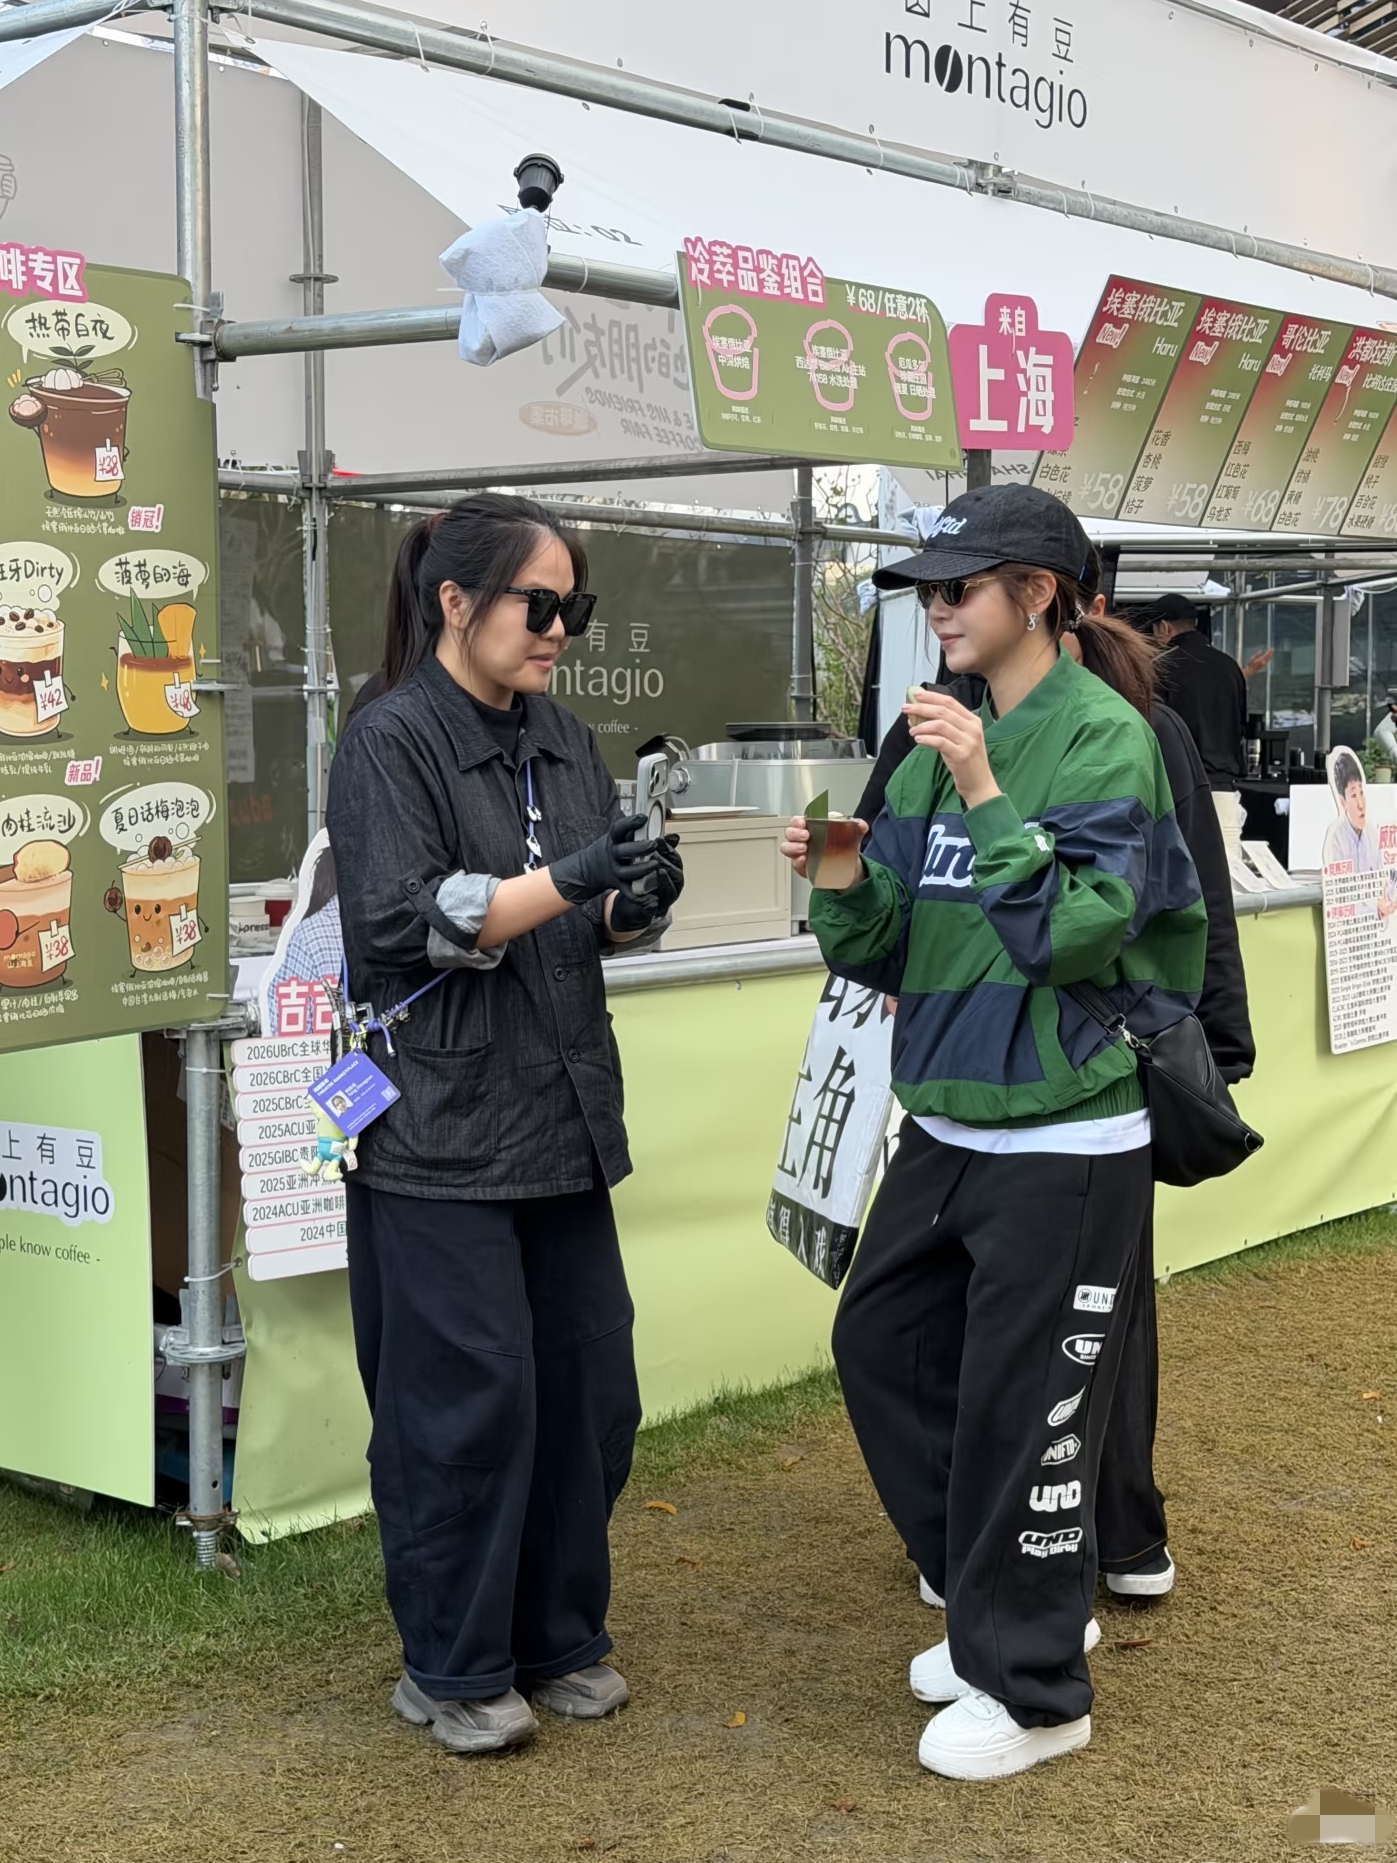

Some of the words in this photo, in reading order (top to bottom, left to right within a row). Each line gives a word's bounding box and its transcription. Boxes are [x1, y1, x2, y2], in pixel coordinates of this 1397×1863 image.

[885, 31, 1088, 129] montagio
[686, 241, 824, 304] 冷萃品鉴组合
[998, 306, 1026, 336] 来自
[1102, 287, 1186, 328] 埃塞俄比亚
[25, 308, 115, 341] 热带白夜
[1196, 308, 1269, 343] 埃塞俄比亚
[1281, 324, 1332, 354] 哥伦比亚
[1152, 336, 1179, 357] Haru
[1238, 353, 1262, 372] Haru
[969, 344, 1055, 434] 上海
[1151, 429, 1172, 447] 花香
[99, 454, 120, 477] ¥38
[1038, 463, 1072, 483] 白色花
[1077, 472, 1125, 511] ¥58
[1165, 482, 1209, 518] ¥58
[1242, 489, 1281, 524] ¥68
[1311, 496, 1349, 530] ¥78
[40, 689, 63, 711] ¥42
[170, 689, 193, 711] ¥48
[597, 719, 630, 733] coffee
[1, 807, 76, 837] 肉桂流沙
[112, 797, 200, 834] 夏日话梅泡泡
[176, 920, 197, 945] ¥38
[45, 935, 69, 961] ¥38
[249, 1065, 329, 1087] 2026CBrC全国
[20, 1235, 52, 1257] know
[55, 1244, 91, 1264] coffee
